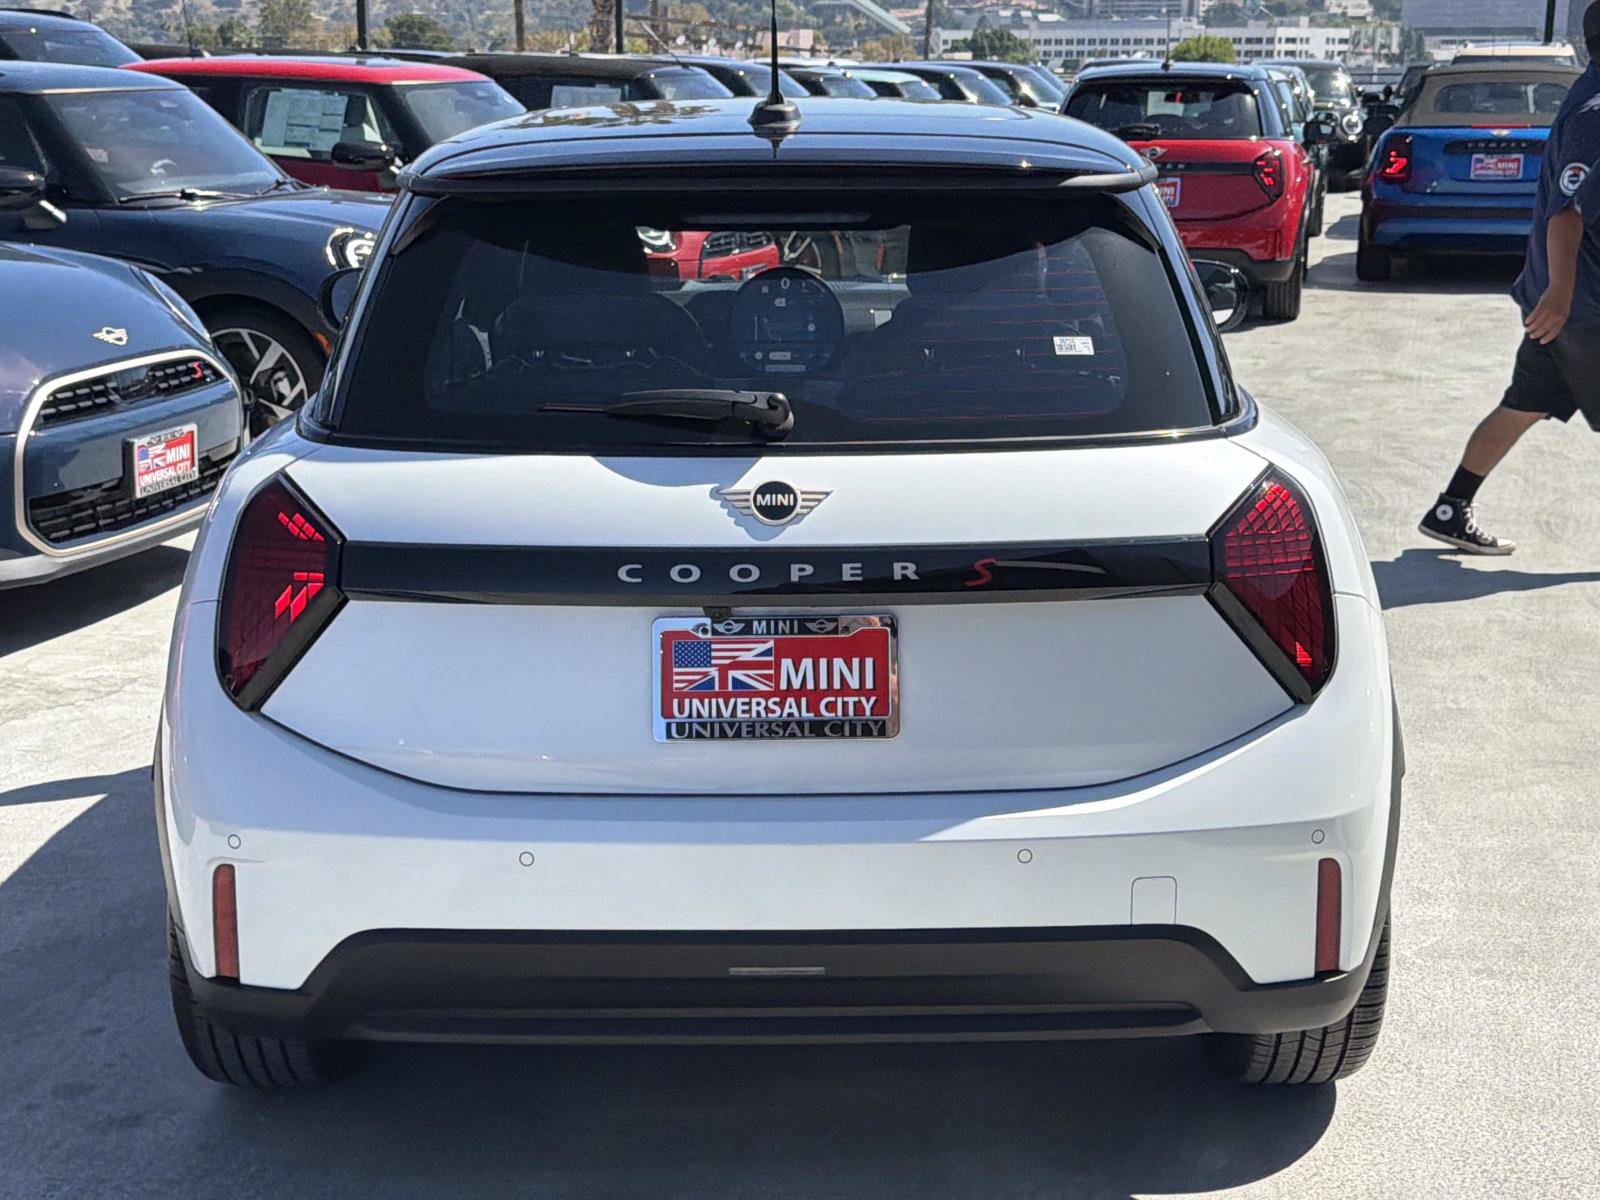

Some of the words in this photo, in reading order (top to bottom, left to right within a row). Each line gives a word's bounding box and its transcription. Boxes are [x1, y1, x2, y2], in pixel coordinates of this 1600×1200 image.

[191, 361, 203, 379] S
[166, 443, 191, 464] MINI
[176, 460, 192, 474] CITY
[756, 494, 795, 507] MINI
[617, 562, 920, 583] COOPER
[964, 557, 997, 587] S
[752, 619, 799, 635] MINI
[779, 657, 875, 690] MINI
[672, 696, 815, 718] UNIVERSAL
[819, 696, 877, 717] CITY
[670, 720, 816, 738] UNIVERSAL
[823, 719, 886, 737] CITY
